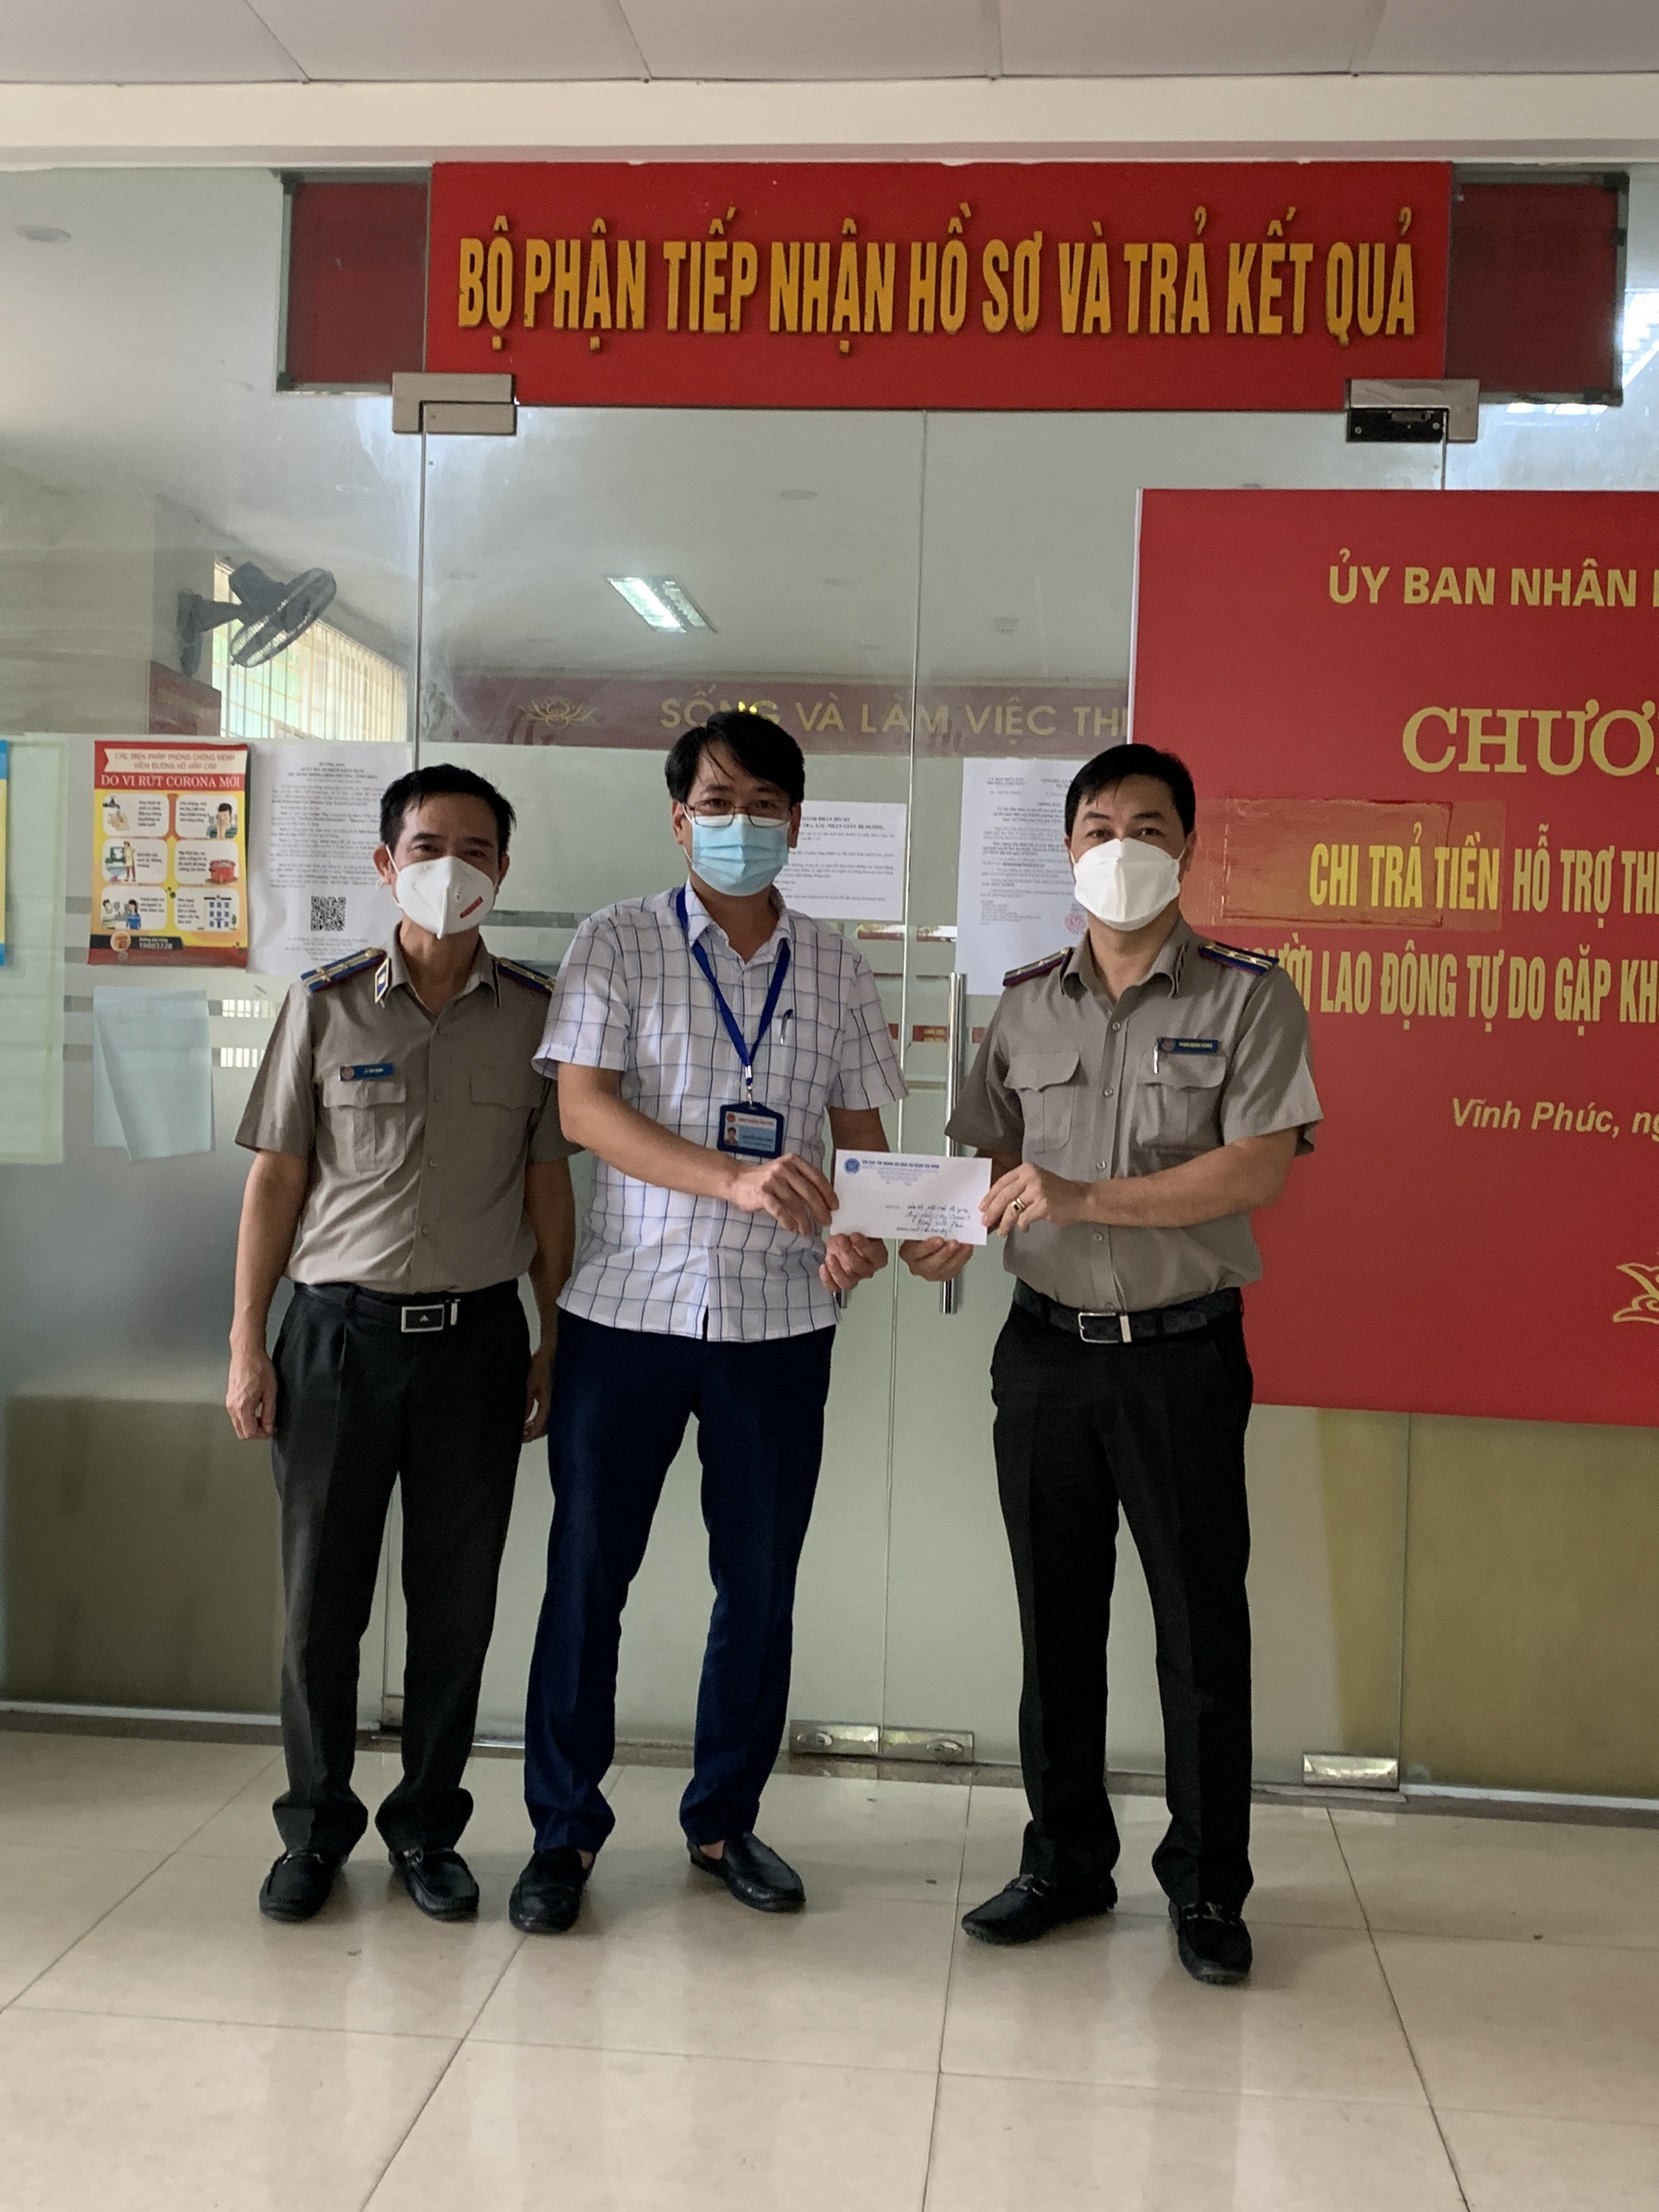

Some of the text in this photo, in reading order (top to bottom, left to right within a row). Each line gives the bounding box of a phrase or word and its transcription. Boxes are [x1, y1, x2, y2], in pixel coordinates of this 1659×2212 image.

[459, 201, 1415, 355] BỘ PHẬN TIẾP NHẬN HỒ SƠ VÀ TRẢ KẾT QUẢ
[1329, 547, 1389, 605] ỦY
[1403, 566, 1496, 606] BAN
[1510, 557, 1637, 607] NHÂN
[795, 691, 846, 733] VÀ
[861, 692, 950, 734] LÀM
[963, 696, 1058, 745] VIỆC
[1402, 698, 1659, 777] CHƯƠ
[101, 774, 119, 786] DO
[122, 775, 135, 787] VI
[166, 776, 217, 788] CORONA
[1308, 842, 1359, 906] CHI
[1368, 822, 1424, 909] TRẢ
[1434, 830, 1500, 911] TIỀN
[1512, 823, 1551, 912] HỖ
[1560, 844, 1616, 929] TRỢ
[1320, 950, 1372, 1014] LAO
[1380, 938, 1459, 1031] ĐỘNG
[1466, 949, 1504, 1033] TỰ
[1508, 956, 1547, 1020] DO
[1554, 944, 1612, 1037] GẶP
[1619, 958, 1659, 1024] KH
[1452, 1097, 1522, 1130] Vĩnh
[1530, 1101, 1620, 1139] Phúc,
